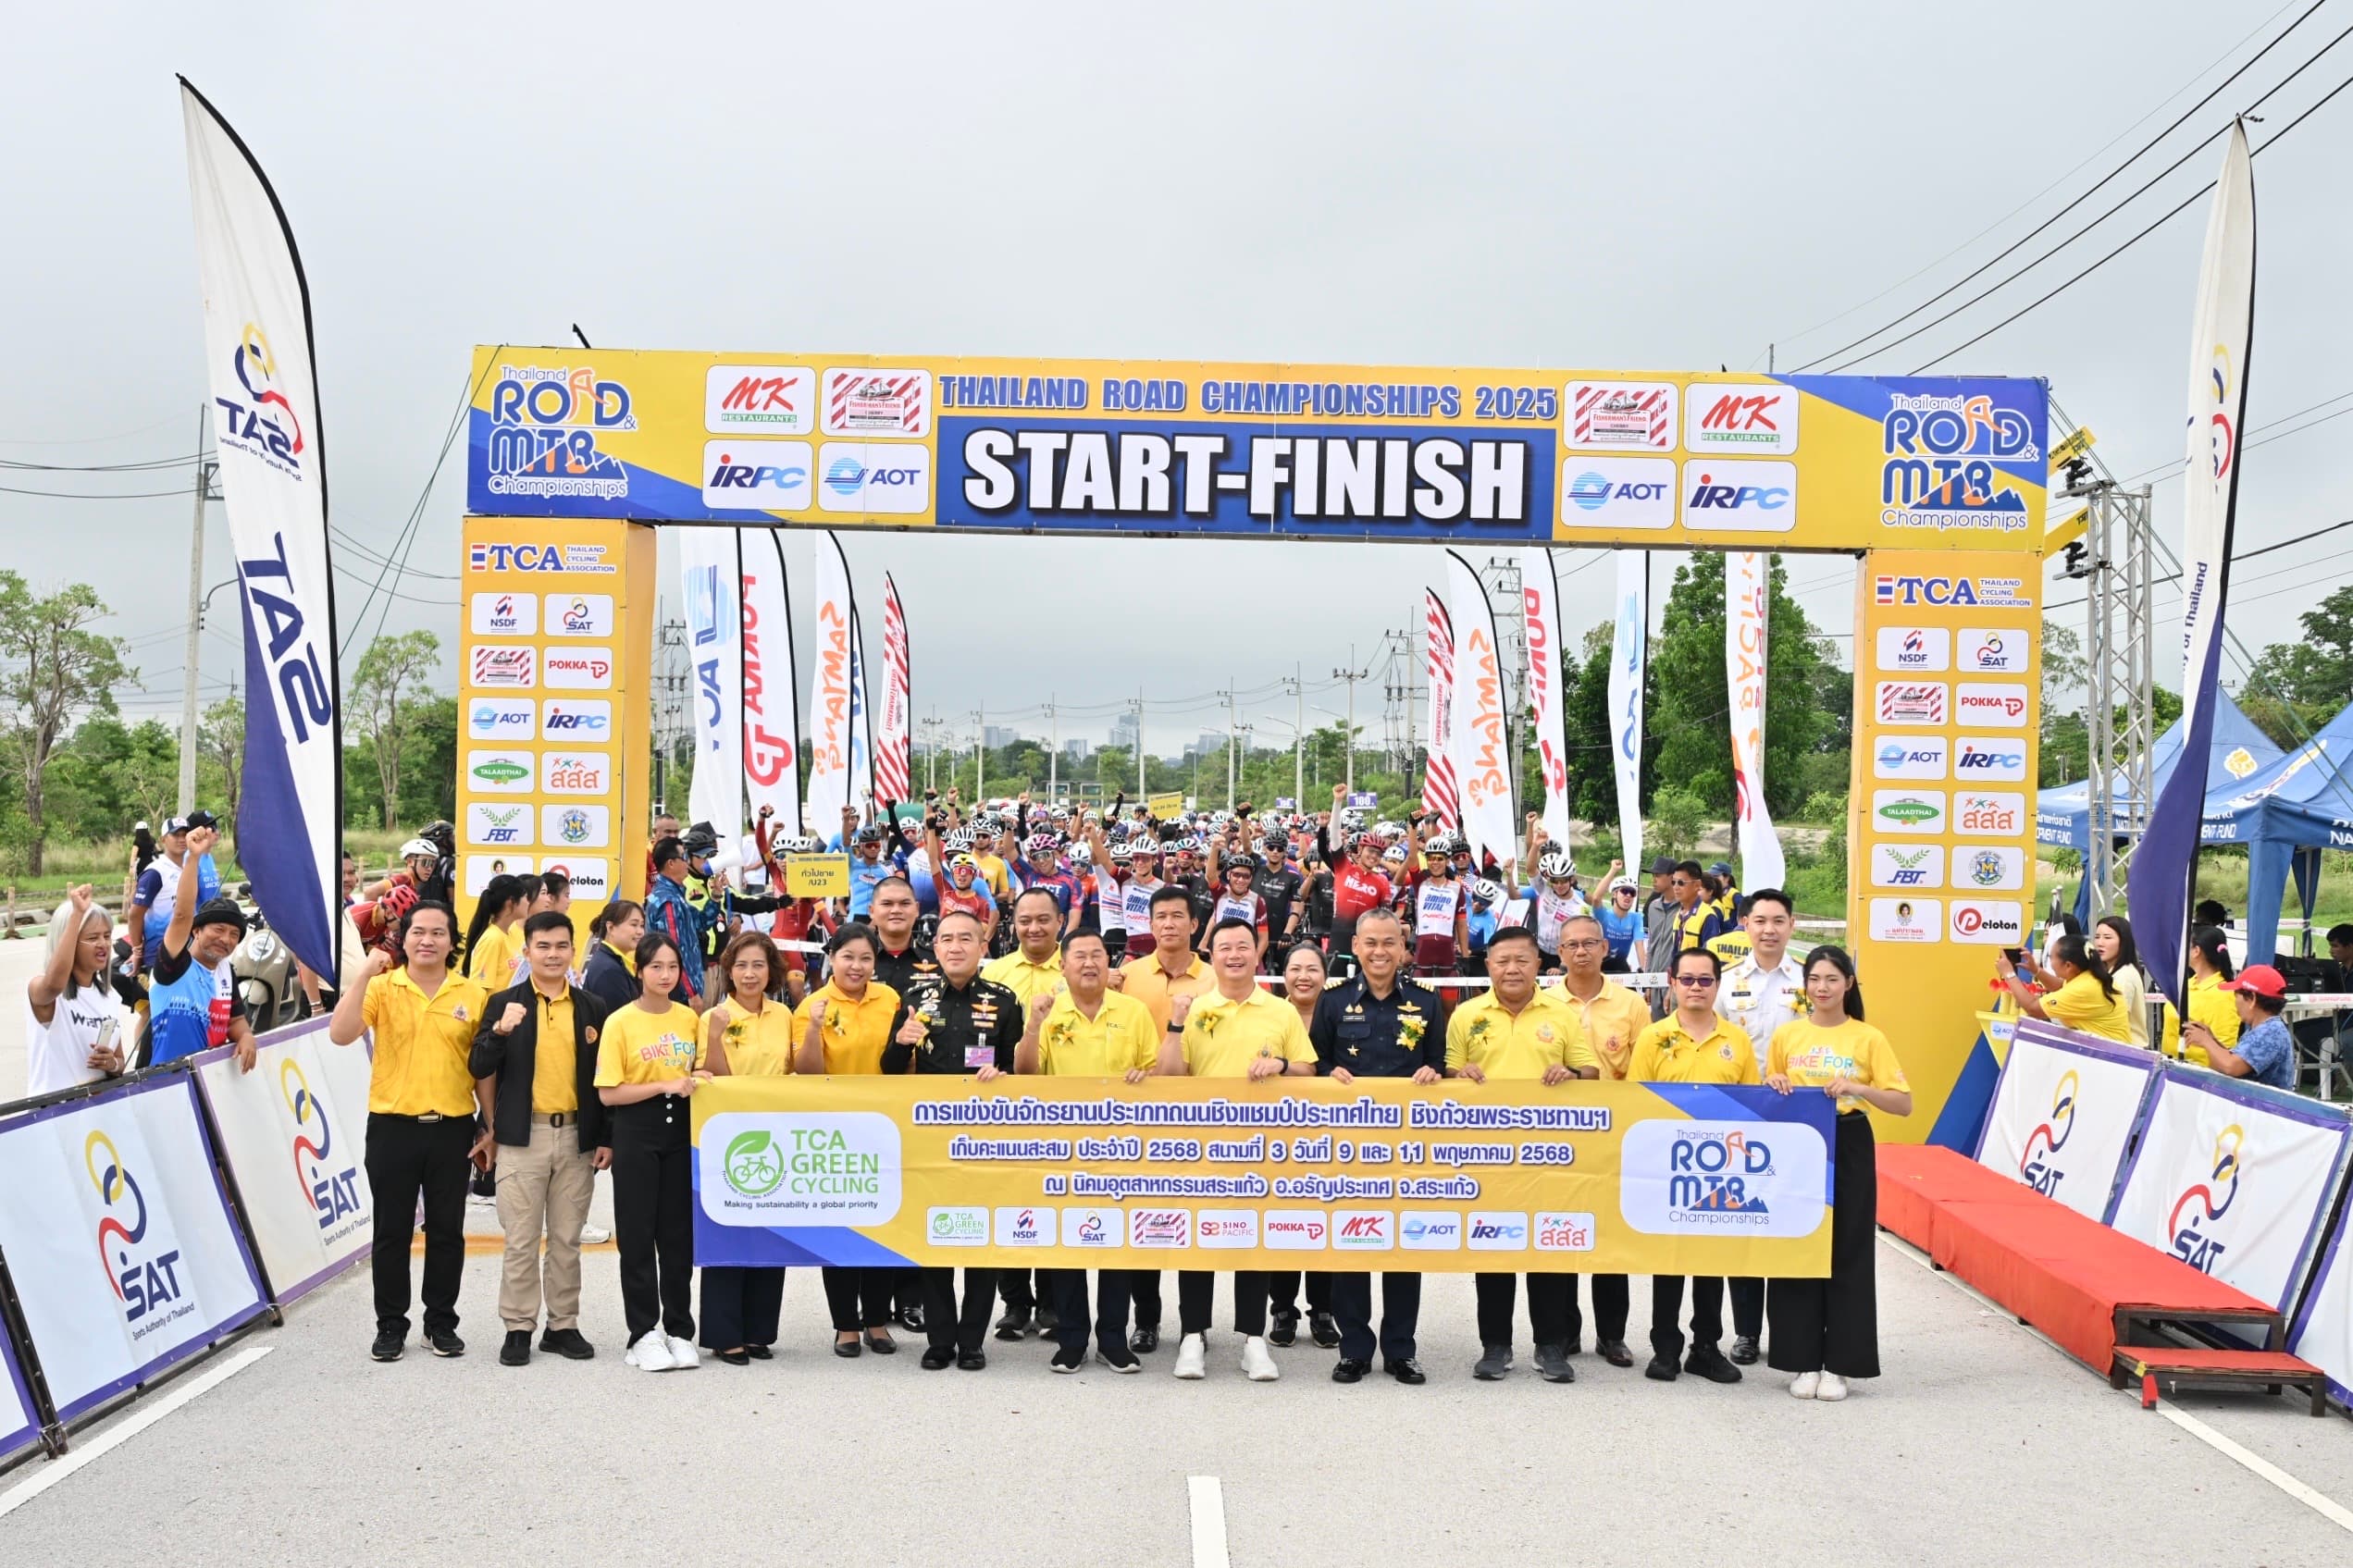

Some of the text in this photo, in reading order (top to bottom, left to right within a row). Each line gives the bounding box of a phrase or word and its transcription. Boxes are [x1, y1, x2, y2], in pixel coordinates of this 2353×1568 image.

[502, 366, 567, 382] Thailand
[492, 369, 631, 424] ROAD
[722, 376, 799, 412] MK
[939, 375, 1556, 419] THAILAND ROAD CHAMPIONSHIPS 2025
[1893, 396, 1963, 411] Thailand
[722, 413, 798, 424] RESTAURANTS
[1702, 395, 1781, 431] MK
[1884, 397, 2031, 456] ROAD
[1702, 432, 1781, 444] RESTAURANTS
[869, 469, 922, 487] AOT
[963, 428, 1525, 520] START-FINISH
[489, 478, 628, 500] Championships
[1615, 483, 1668, 501] AOT
[1880, 510, 2027, 531] Championships
[489, 545, 564, 571] TCA
[565, 564, 615, 573] ASSOCIATION
[1980, 579, 2021, 587] THAILAND
[1897, 577, 1978, 605] TCA
[2185, 562, 2208, 627] Thailand
[1979, 599, 2031, 607] ASSOCIATION
[490, 619, 518, 628] NSDF
[565, 620, 594, 631] SAT
[549, 661, 588, 670] POKKA
[1899, 654, 1928, 662] NSDF
[1979, 655, 2009, 667] SAT
[1961, 698, 2002, 707] POKKA
[499, 713, 530, 724] AOT
[1908, 752, 1942, 762] AOT
[550, 770, 601, 789] สสส
[1355, 796, 1370, 807] 100
[1963, 809, 2014, 830] สสส
[482, 829, 519, 842] FBT
[1887, 870, 1926, 883] FBT
[1344, 875, 1378, 896] HERO
[1126, 894, 1150, 905] amin
[1422, 902, 1445, 911] VITAL
[1425, 894, 1452, 905] amino
[1222, 906, 1250, 919] amino
[1954, 907, 2018, 936] Peloton
[1787, 1056, 1854, 1069] BIKE FOR
[914, 1099, 1608, 1128] การแข่งขันจักรยานประเภทถนนชิงแชมป์ประเทศไทย ชิงถ้วยพระราชทานฯ
[790, 1130, 847, 1151] TCA
[1677, 1130, 1725, 1140] Thailand
[951, 1136, 1570, 1164] เก็บคะแนนสะสม ประจำปี 2568 สนามที่ 3 วันที่ 9 และ 11 พฤษภาคม 2568
[790, 1154, 879, 1174] GREEN
[790, 1177, 879, 1194] CYCLING
[1046, 1175, 1476, 1198] ณ นิคมอุตสาหกรรมสระแก้ว อ.อรัญประเทศ จ.สระแก้ว
[313, 1167, 361, 1229] SAT
[724, 1200, 753, 1209] Making
[756, 1200, 810, 1209] sustainability
[821, 1200, 846, 1209] global
[848, 1200, 878, 1209] priority
[955, 1220, 985, 1228] GREEN
[1668, 1210, 1769, 1227] Championships
[1221, 1228, 1255, 1237] PACIFIC
[1268, 1222, 1306, 1231] POKKA
[1341, 1216, 1385, 1237] MK
[1428, 1225, 1456, 1235] AOT
[1012, 1230, 1038, 1239] NSDF
[1082, 1232, 1107, 1241] SAT
[2167, 1228, 2226, 1276] SAT
[120, 1250, 181, 1323] SAT
[132, 1327, 146, 1340] Sports
[145, 1316, 167, 1334] Authority
[171, 1302, 195, 1318] Thailand
